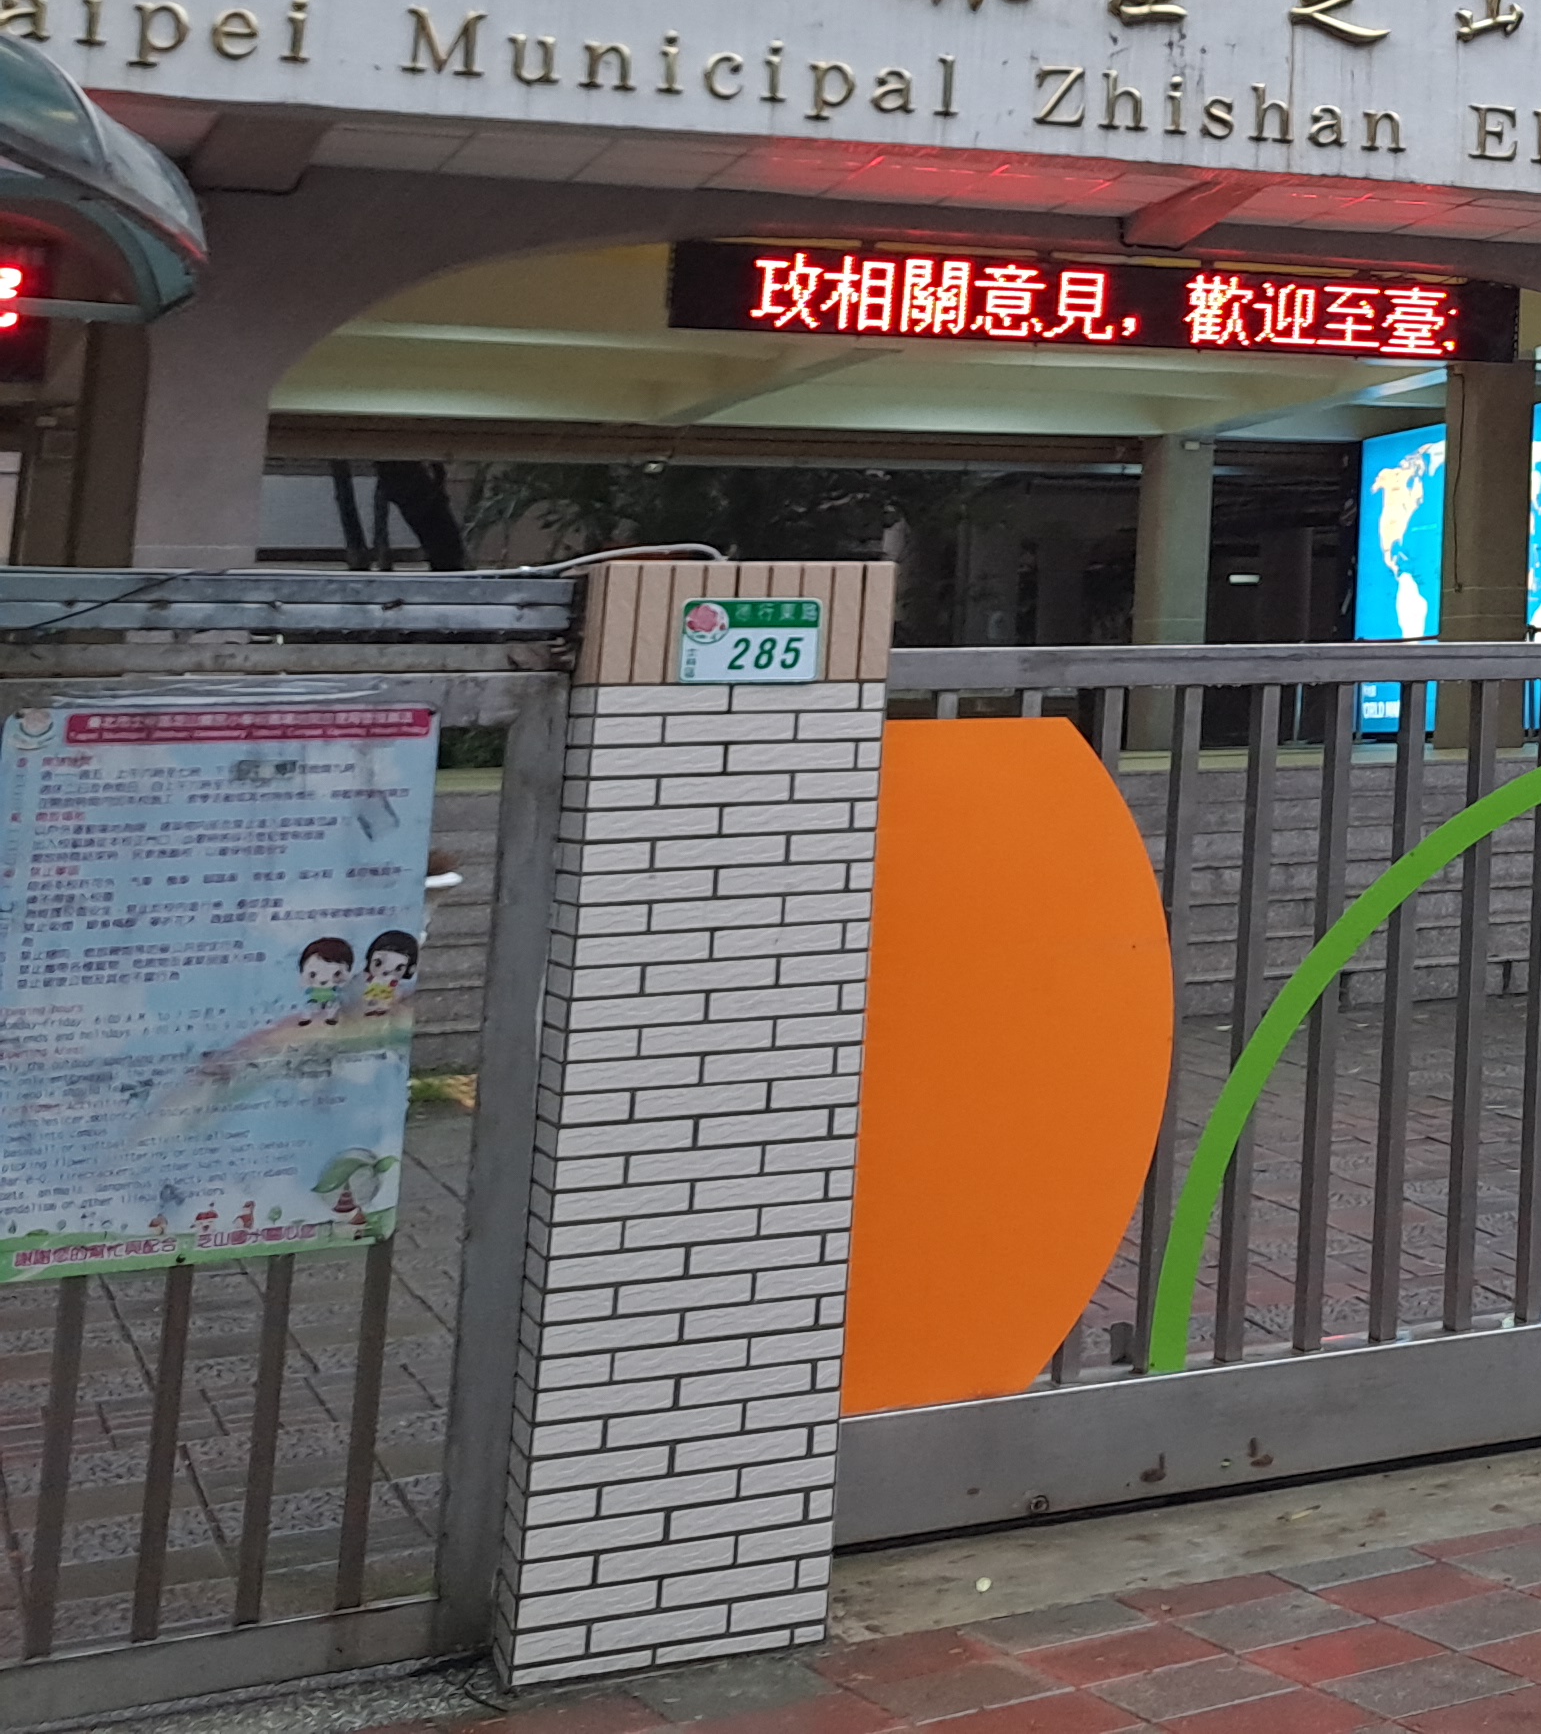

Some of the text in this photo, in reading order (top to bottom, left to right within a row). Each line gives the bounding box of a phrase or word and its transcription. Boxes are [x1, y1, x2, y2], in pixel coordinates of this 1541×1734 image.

[401, 3, 960, 120] Municipal
[1034, 63, 1407, 154] Zhishan
[727, 637, 804, 670] 285
